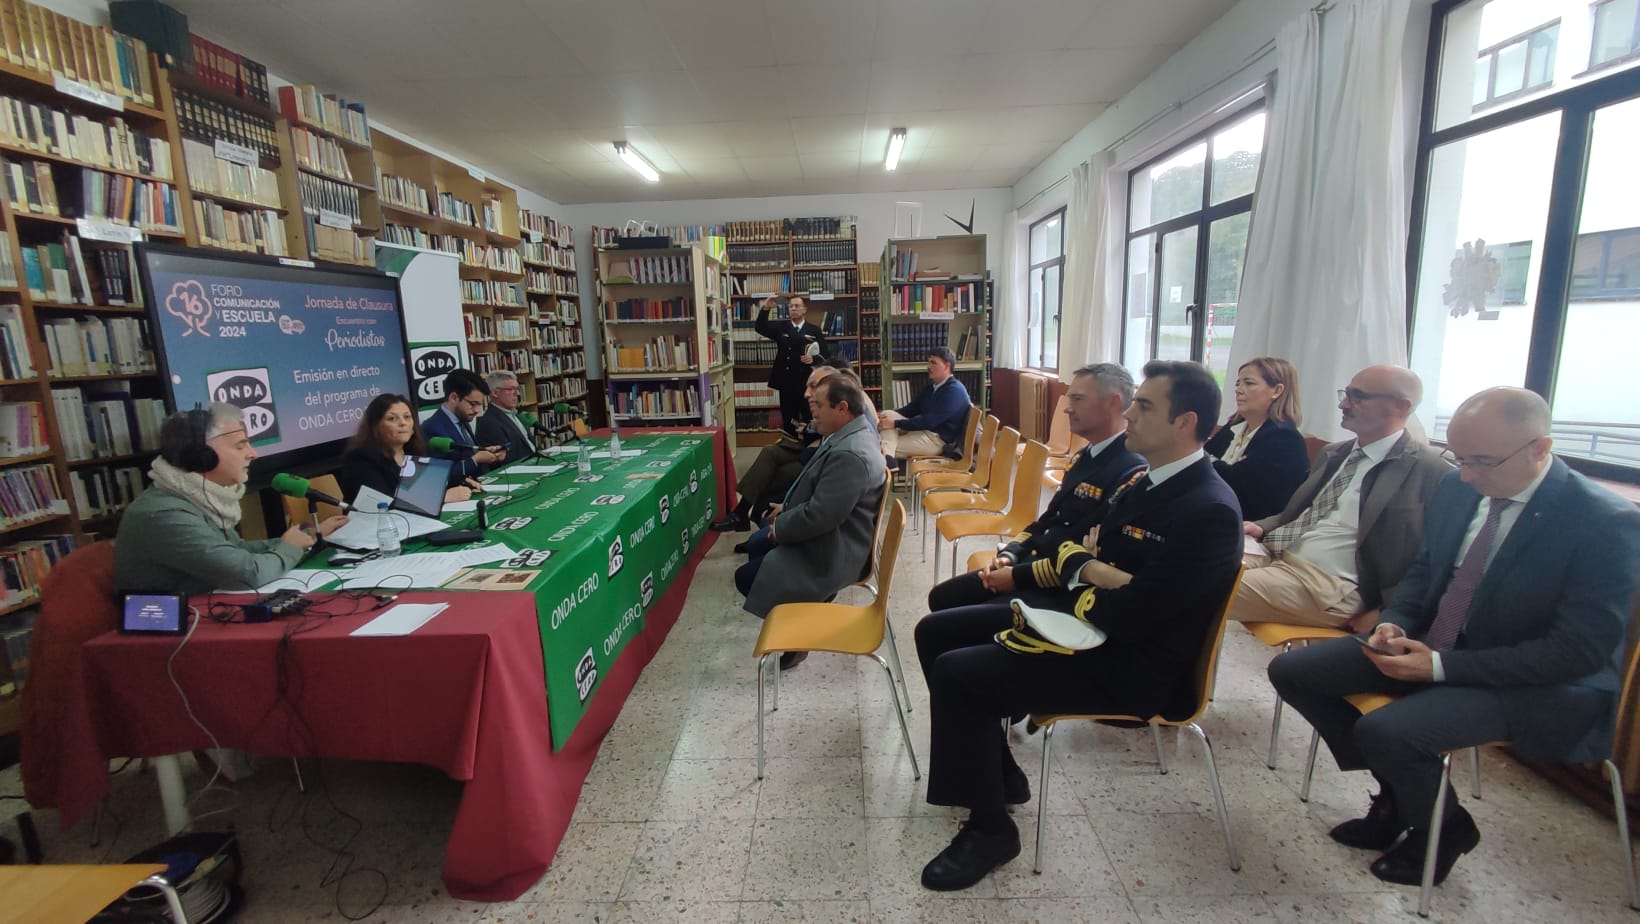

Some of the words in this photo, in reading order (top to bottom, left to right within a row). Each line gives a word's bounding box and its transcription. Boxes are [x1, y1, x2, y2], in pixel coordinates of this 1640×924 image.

[211, 284, 242, 297] FORO
[180, 291, 203, 315] 16
[214, 298, 280, 309] COMUNICACIÓN
[304, 295, 344, 309] Jornada
[346, 298, 358, 310] de
[359, 298, 394, 311] Clausura
[222, 310, 276, 323] ESCUELA
[219, 326, 247, 337] 2024
[324, 328, 385, 352] Periodistas
[417, 357, 454, 372] ONDA
[293, 367, 335, 384] Emisión
[336, 369, 349, 380] en
[350, 365, 381, 379] directo
[217, 383, 264, 404] ONDA
[304, 391, 322, 406] del
[323, 388, 368, 407] programa
[369, 384, 381, 396] de
[424, 380, 440, 396] CE
[249, 412, 268, 429] RO
[298, 412, 335, 431] ONDA
[335, 407, 364, 424] CERO
[551, 592, 577, 630] ONDA
[577, 572, 599, 604] CERO
